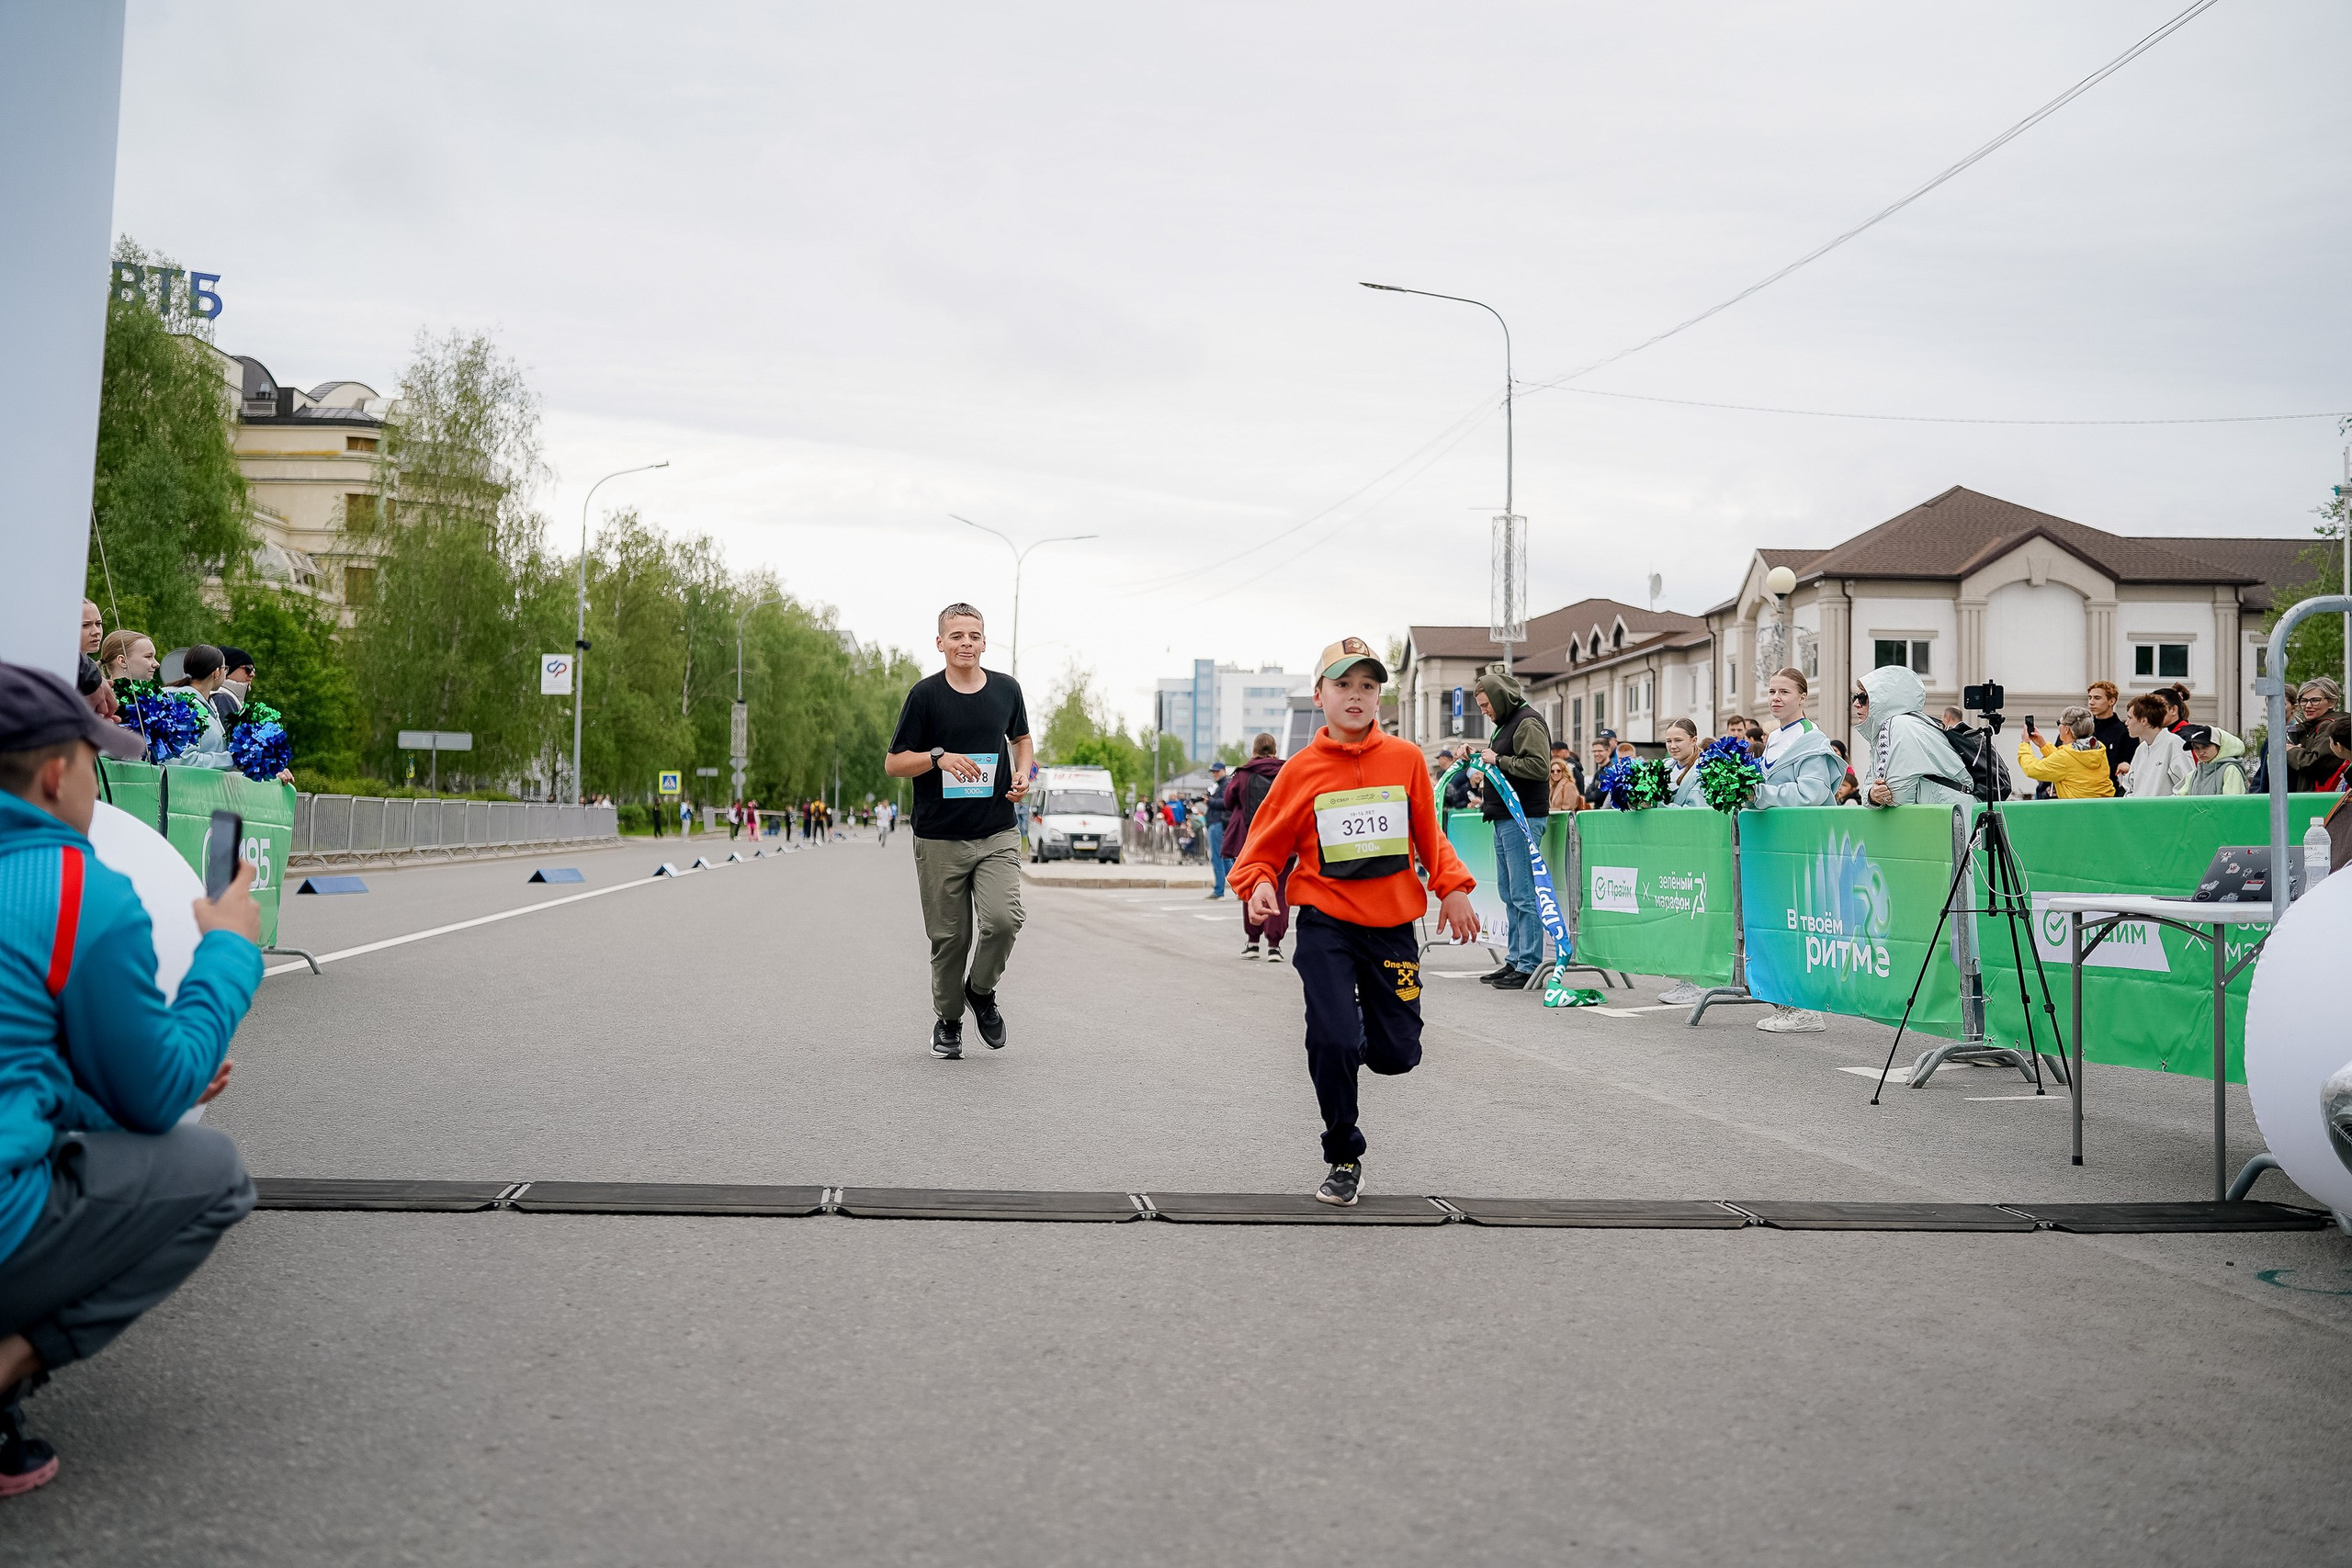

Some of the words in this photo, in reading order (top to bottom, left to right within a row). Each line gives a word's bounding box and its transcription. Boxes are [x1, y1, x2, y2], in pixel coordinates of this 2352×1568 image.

[112, 261, 223, 320] ВТБ
[1341, 816, 1388, 836] 3218
[1607, 879, 1632, 901] Прайм
[1658, 871, 1693, 891] зелёный
[1655, 891, 1690, 913] марафон
[1786, 908, 1798, 930] В
[1800, 911, 1843, 935] твоём
[1805, 936, 1891, 978] ритме
